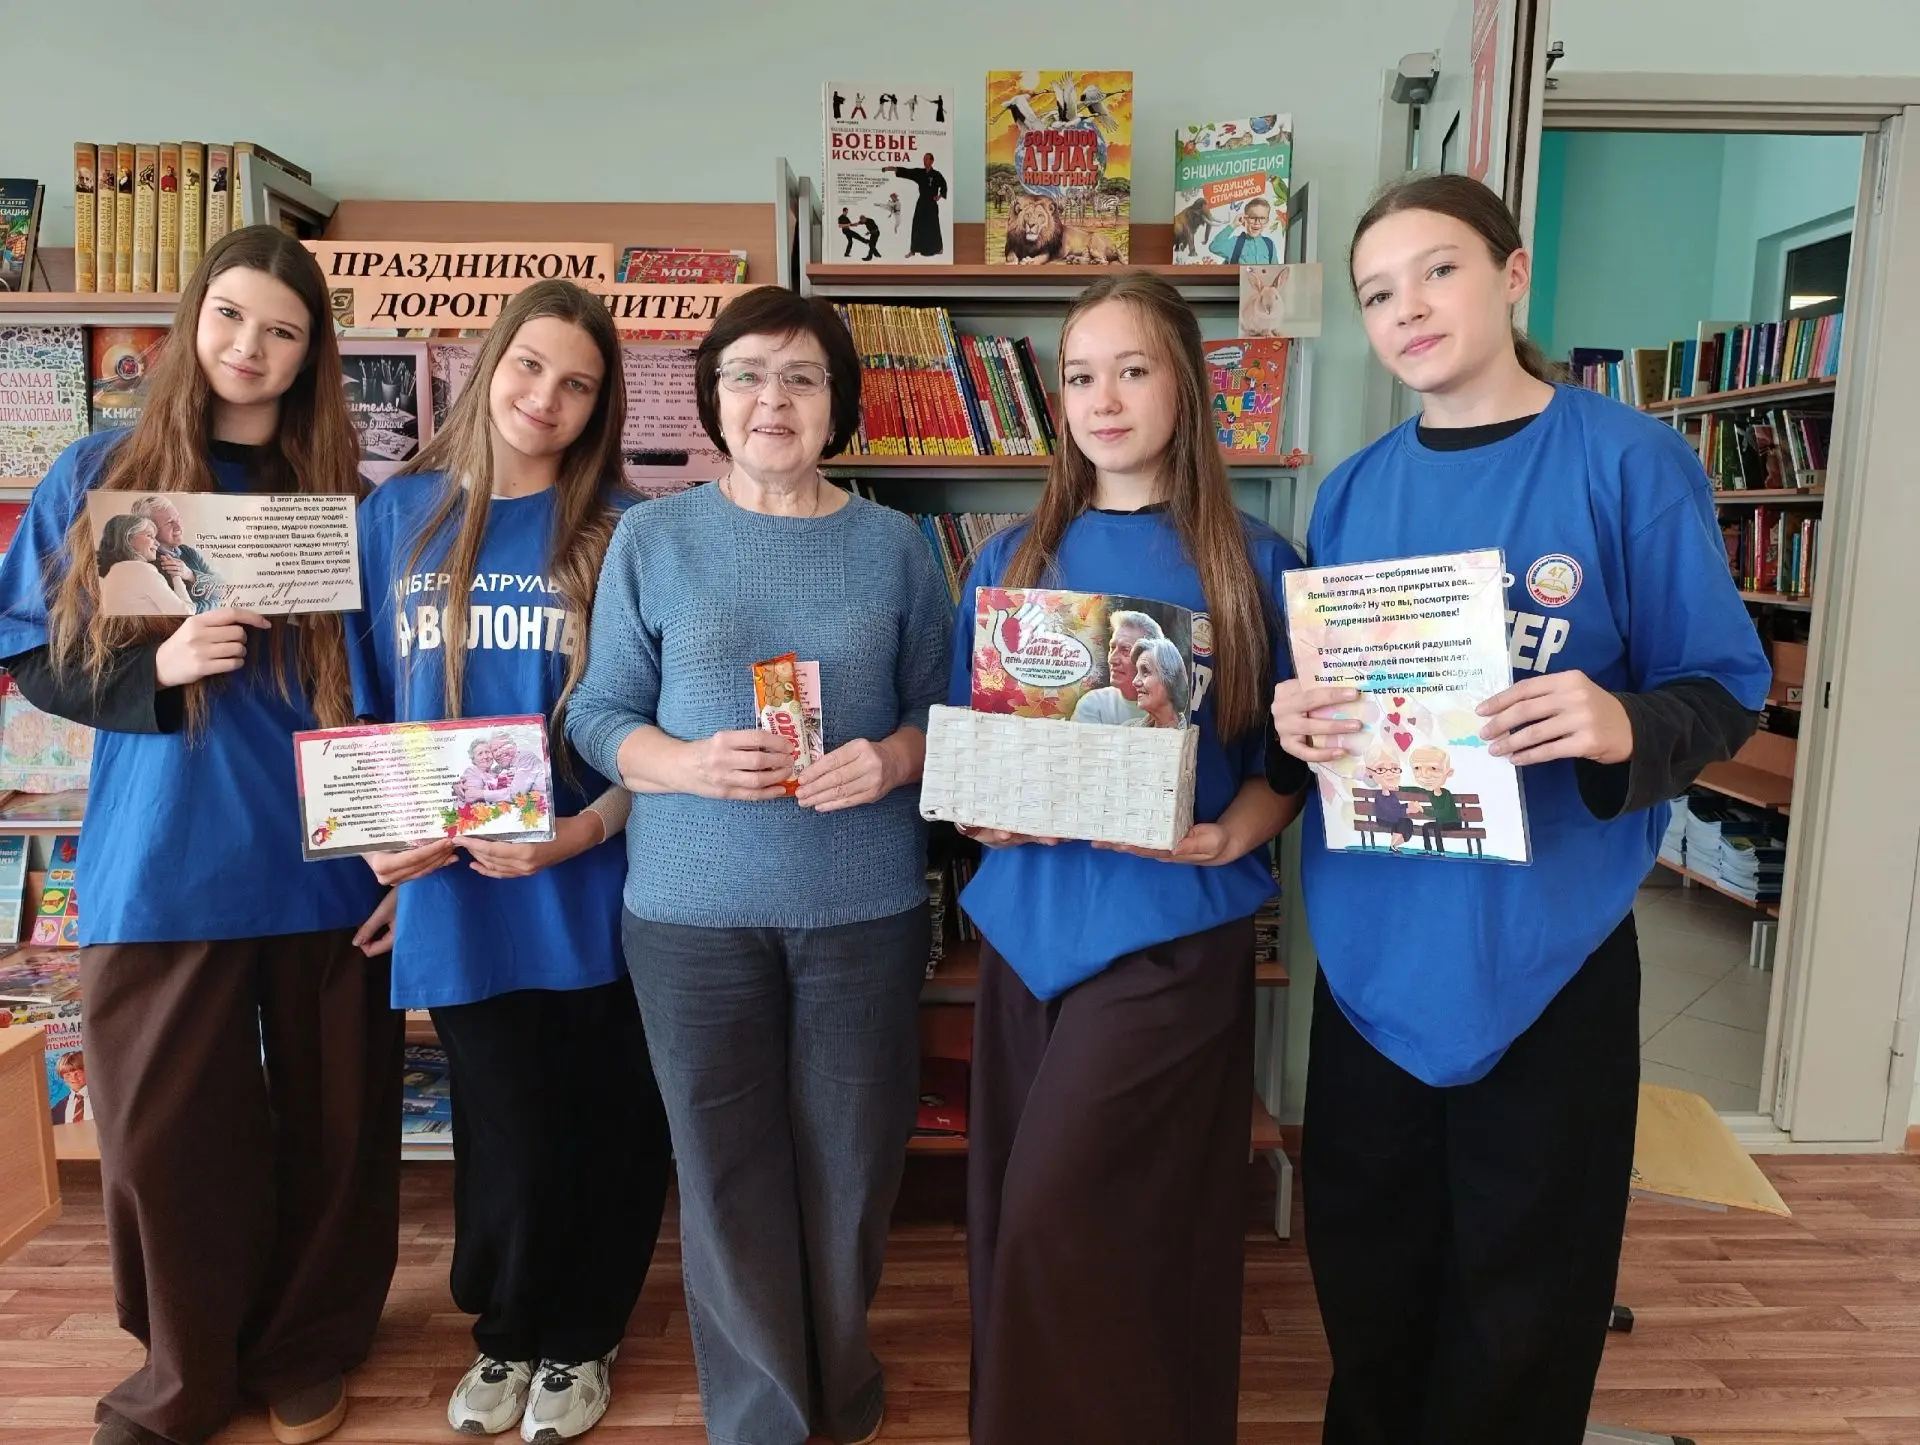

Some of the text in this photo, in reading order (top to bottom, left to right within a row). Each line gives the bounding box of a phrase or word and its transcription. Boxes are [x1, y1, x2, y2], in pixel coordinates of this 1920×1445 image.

[832, 133, 918, 151] БОЕВЫЕ
[1023, 129, 1099, 148] БОЛЬШОЙ
[832, 150, 911, 162] ИСКУССТВА
[1022, 146, 1099, 172] АТЛАС
[1182, 153, 1285, 181] ЭНЦИКЛОПЕДИЯ
[1022, 171, 1099, 187] ЖИВОТНЫХ
[1212, 177, 1256, 194] БУДУЩИХ
[1210, 185, 1262, 204] ОТЛИЧНИКОВ
[161, 193, 169, 248] ШКОЛЬНАЯ
[329, 252, 606, 283] ПРАЗДНИКОМ,
[660, 268, 703, 277] МОЯ
[602, 294, 723, 319] ЧИТЕЛ
[0, 372, 52, 388] САМАЯ
[0, 390, 55, 405] ПОЛНАЯ
[350, 397, 400, 412] ителя!
[102, 408, 146, 419] КНИГ
[294, 496, 311, 504] день
[196, 533, 218, 541] Пусть
[211, 552, 244, 560] Желаем,
[297, 568, 330, 576] радостью
[1322, 565, 1457, 584] В волосах серебряные нити,
[1548, 565, 1567, 579] 47
[1307, 589, 1335, 600] Ясный
[1336, 590, 1366, 598] взгляд
[1366, 586, 1396, 594] из-под
[1397, 580, 1450, 593] прикрытых
[1367, 601, 1380, 610] Ну
[1381, 599, 1396, 608] что
[1397, 599, 1413, 607] вы,
[1413, 593, 1470, 605] посмотрите:
[1324, 607, 1460, 627] Умудренный жизнью человек!
[1317, 637, 1472, 655] В этот день октябрьский радушный
[1004, 656, 1087, 668] ДЕНЬ ДОБРА И УВАЖЕНИЯ
[1322, 659, 1368, 669] Вспомните
[1368, 656, 1398, 667] людей
[1398, 656, 1449, 665] почтенных
[1314, 674, 1344, 683] Возраст
[1366, 673, 1387, 681] ведь
[1387, 672, 1415, 680] виден
[1416, 669, 1441, 678] лишь
[1388, 686, 1401, 694] тот
[1416, 684, 1444, 694] яркий
[322, 739, 332, 756] 1
